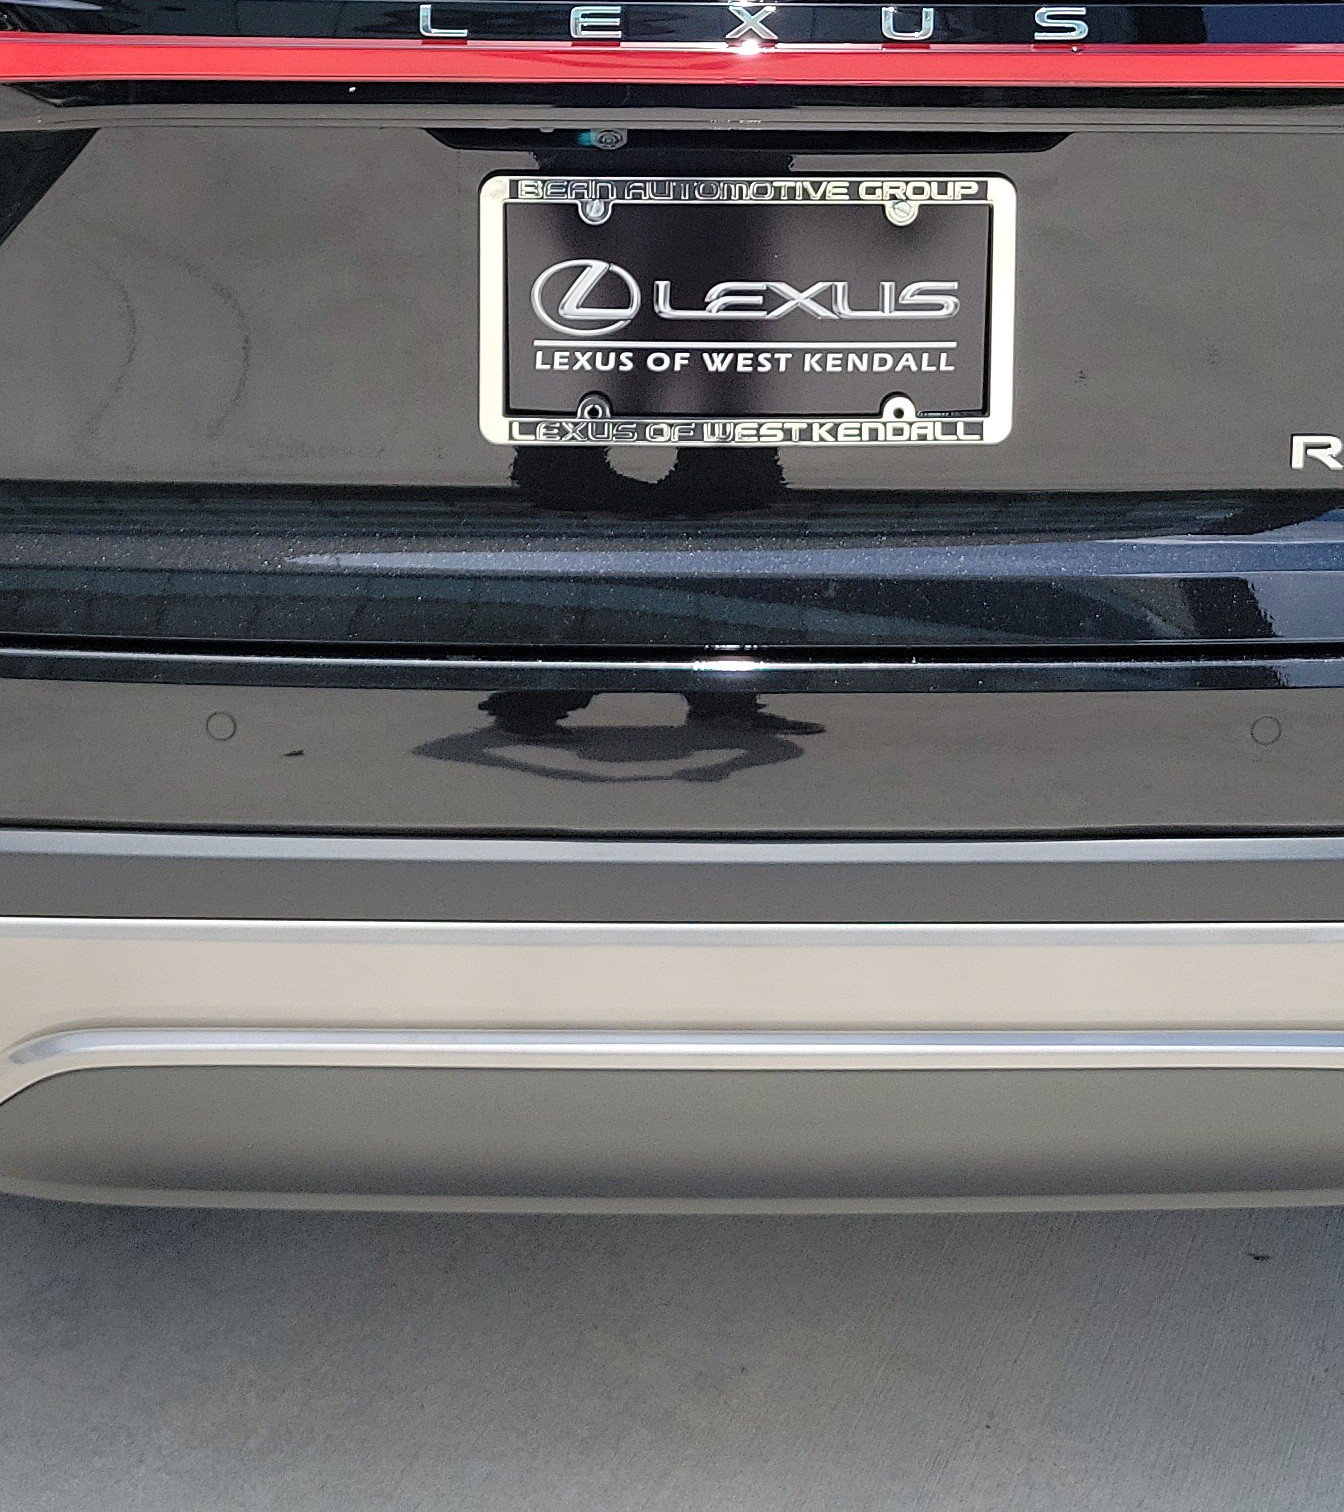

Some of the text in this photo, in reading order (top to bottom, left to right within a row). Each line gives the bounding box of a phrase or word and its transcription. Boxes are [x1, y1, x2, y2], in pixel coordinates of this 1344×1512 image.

[419, 3, 1089, 41] LEXUS
[517, 180, 979, 200] BEAN AUTOMOTIVE GROUP
[654, 280, 960, 320] LEXUS
[535, 351, 955, 372] LEXUS OF WEST KENDALL
[510, 421, 981, 442] LEXUS OF WEST KENDALL
